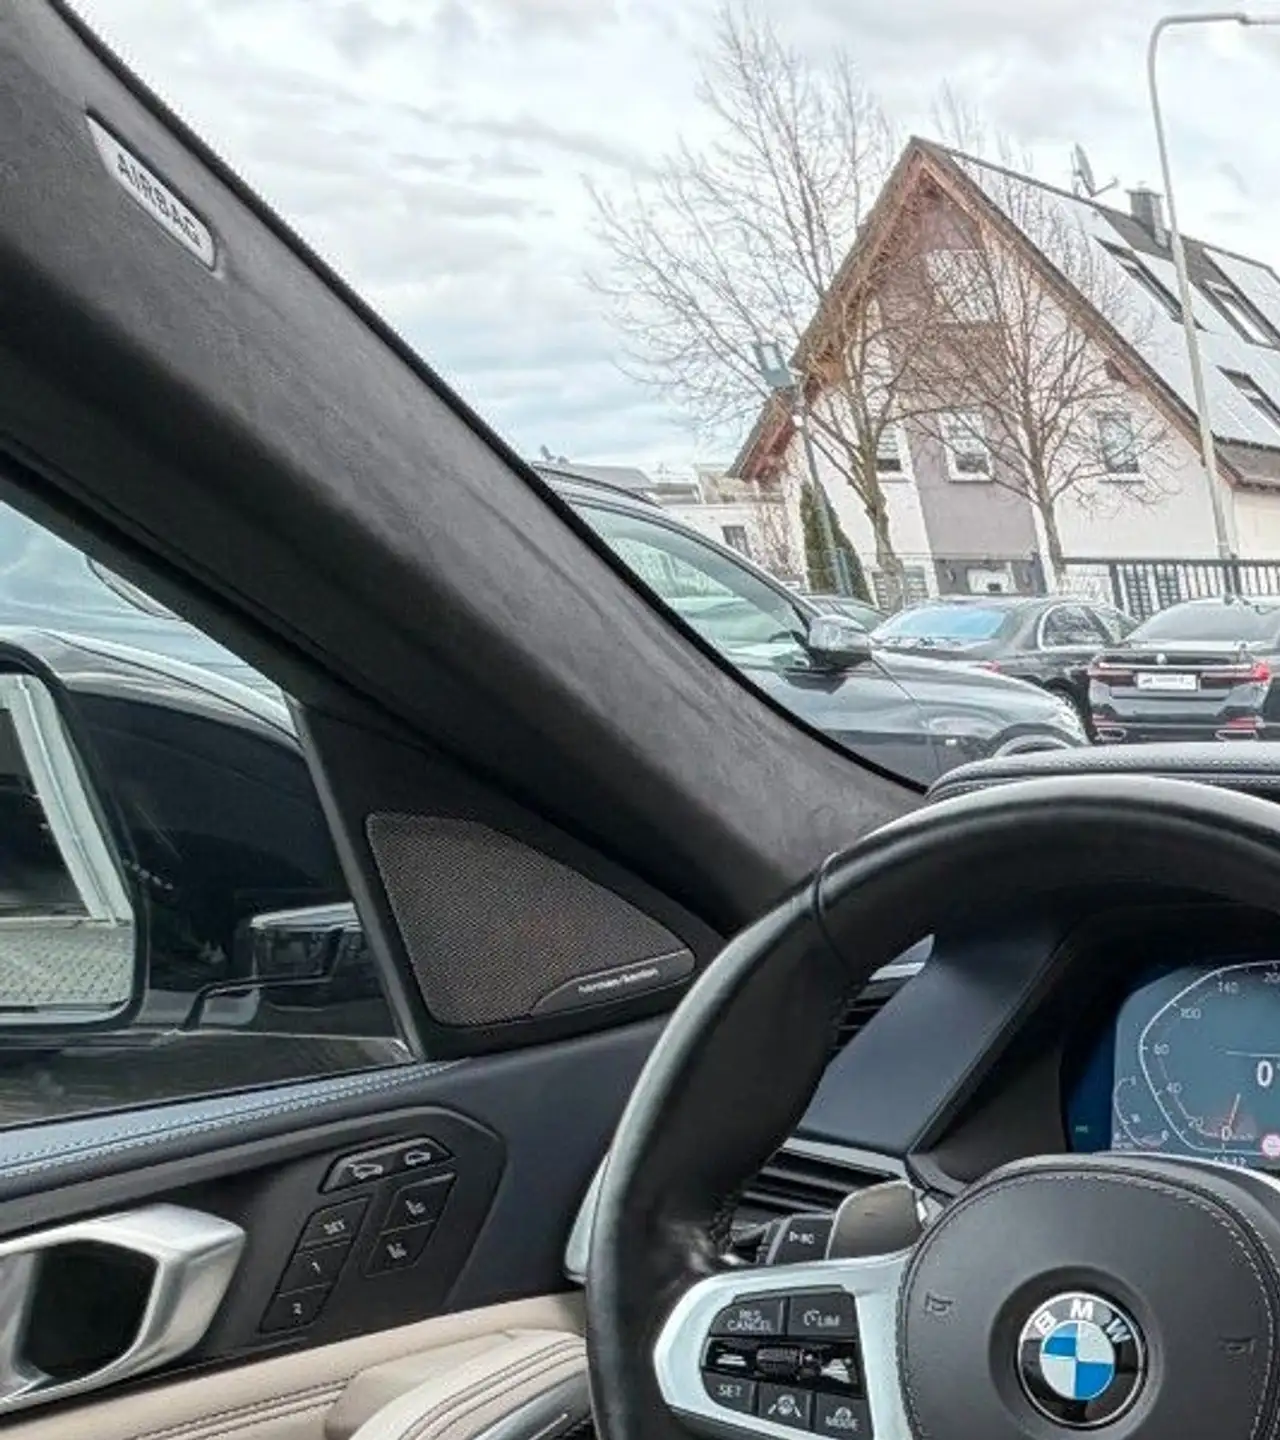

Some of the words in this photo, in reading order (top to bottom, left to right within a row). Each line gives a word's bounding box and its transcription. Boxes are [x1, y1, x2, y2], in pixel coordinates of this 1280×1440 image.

[117, 152, 203, 249] AIRBAG
[1256, 1060, 1274, 1088] 0
[1034, 1298, 1132, 1345] BMW
